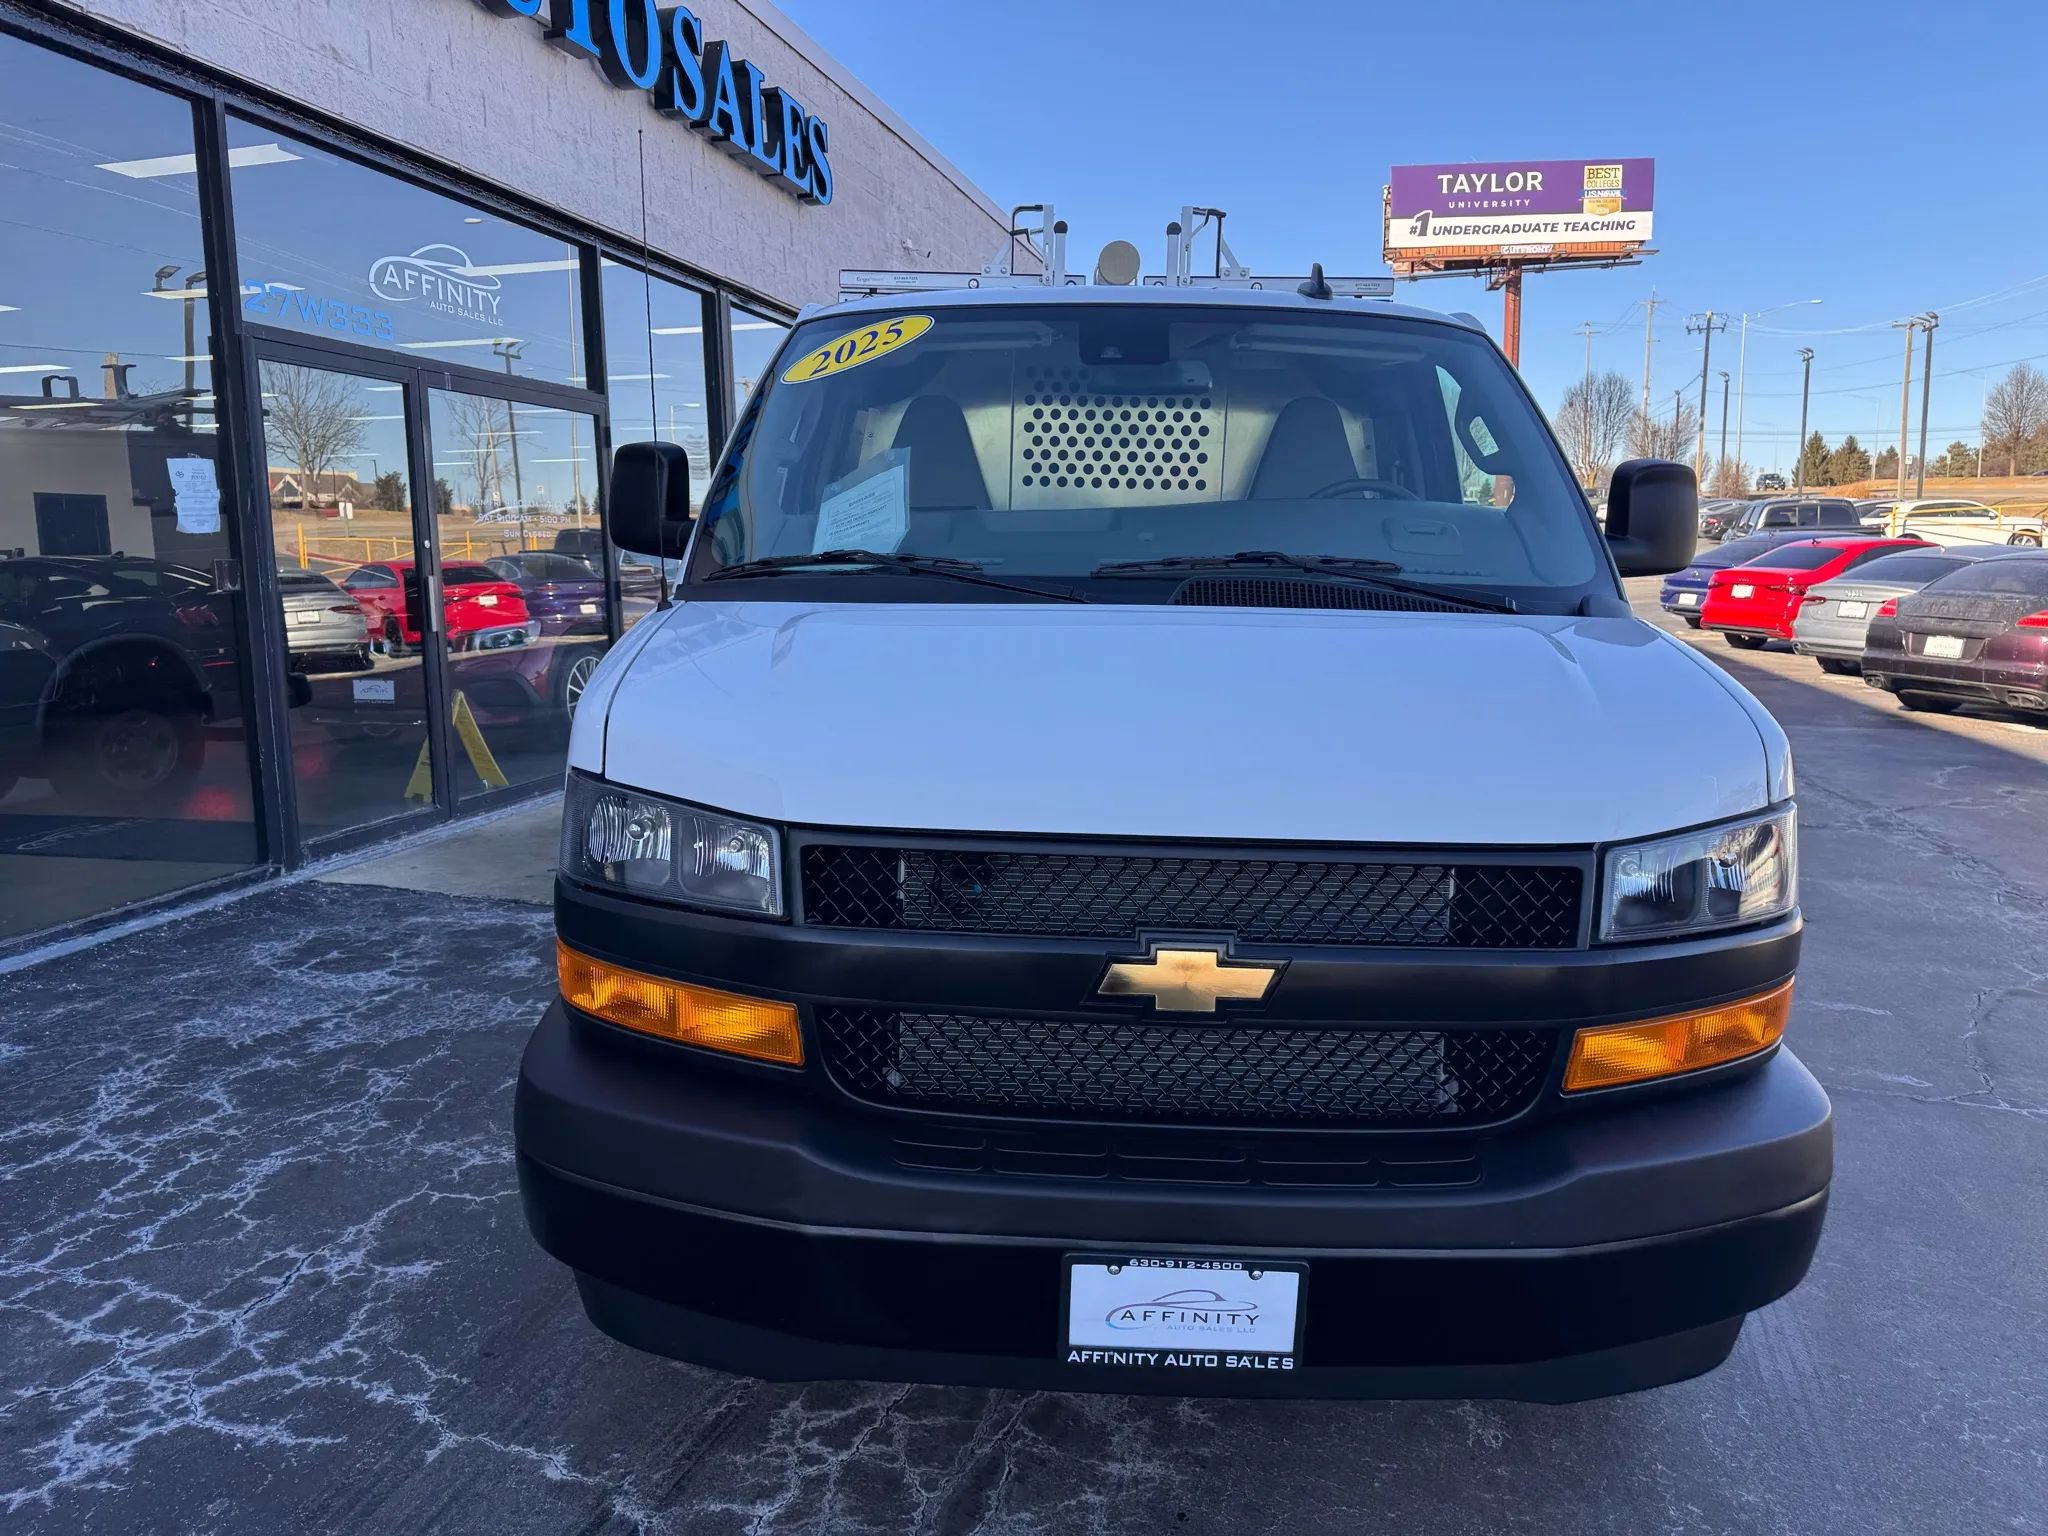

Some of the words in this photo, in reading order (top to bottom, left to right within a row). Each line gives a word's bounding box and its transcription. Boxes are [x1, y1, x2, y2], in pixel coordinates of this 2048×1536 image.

[1587, 167, 1620, 179] BEST
[1437, 171, 1544, 194] TAYLOR
[1586, 179, 1620, 188] COLLEGES
[1448, 199, 1531, 209] UNIVERSITY
[1432, 222, 1559, 236] UNDERGRADUATE
[1564, 220, 1636, 232] TEACHING
[382, 263, 501, 315] AFFINITY
[244, 279, 394, 342] 27W333
[429, 300, 454, 315] AUTO
[457, 307, 486, 323] SALES
[488, 317, 505, 327] LLC
[809, 319, 905, 377] 2025
[1129, 1258, 1243, 1271] 630-912-4500
[1120, 1309, 1260, 1326] AFFINITY
[1167, 1323, 1196, 1332] AUTO
[1198, 1325, 1233, 1333] SALES
[1236, 1326, 1256, 1334] LLC
[1067, 1350, 1160, 1367] AFFINITY
[1164, 1353, 1218, 1367] AUTO
[1225, 1354, 1294, 1370] SALES
